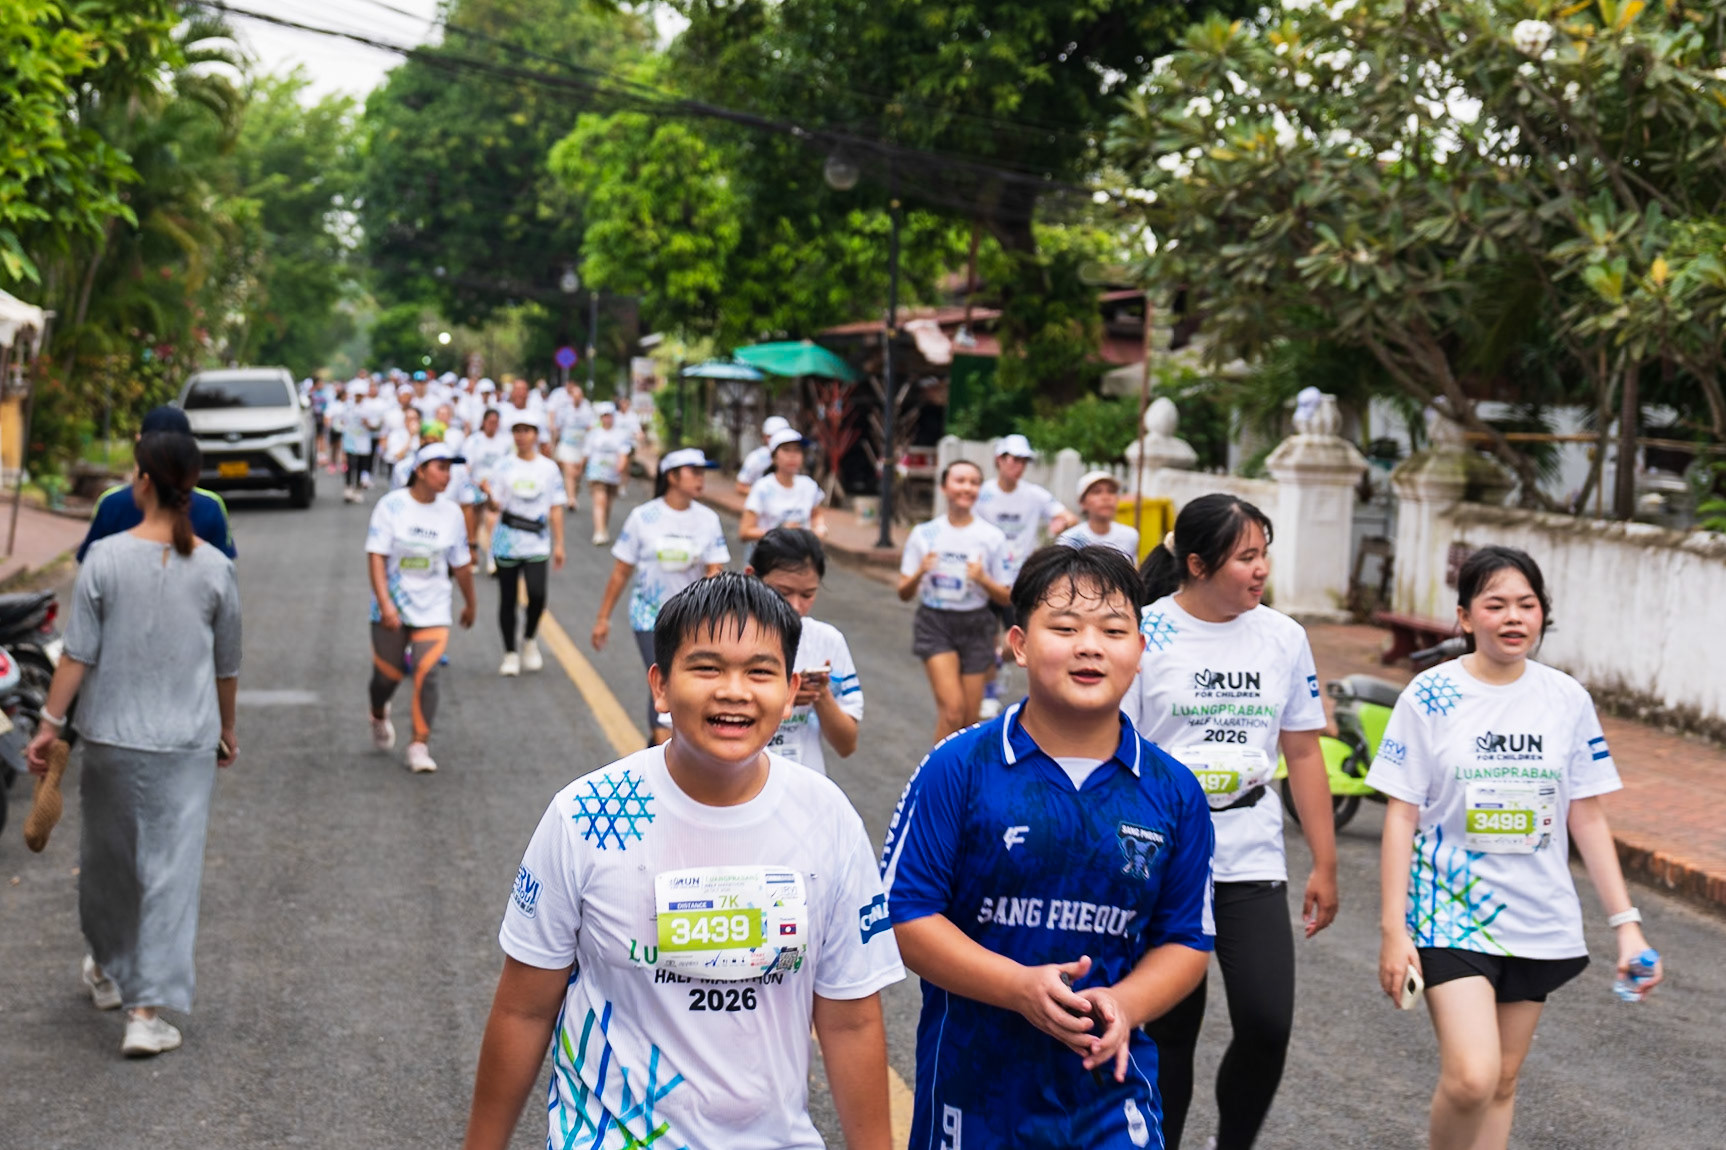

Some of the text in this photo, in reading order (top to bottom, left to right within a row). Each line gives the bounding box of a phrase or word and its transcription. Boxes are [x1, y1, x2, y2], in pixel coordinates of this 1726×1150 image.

[1212, 672, 1260, 690] RUN
[1188, 716, 1269, 728] HALF MARATHON
[1204, 729, 1248, 744] 2026
[1492, 734, 1543, 752] RUN
[1197, 773, 1232, 790] 497
[1474, 812, 1527, 830] 3498
[677, 901, 707, 910] DISTANCE
[719, 895, 740, 908] 7K
[977, 896, 1044, 928] SANG
[671, 914, 750, 945] 3439
[688, 987, 757, 1012] 2026
